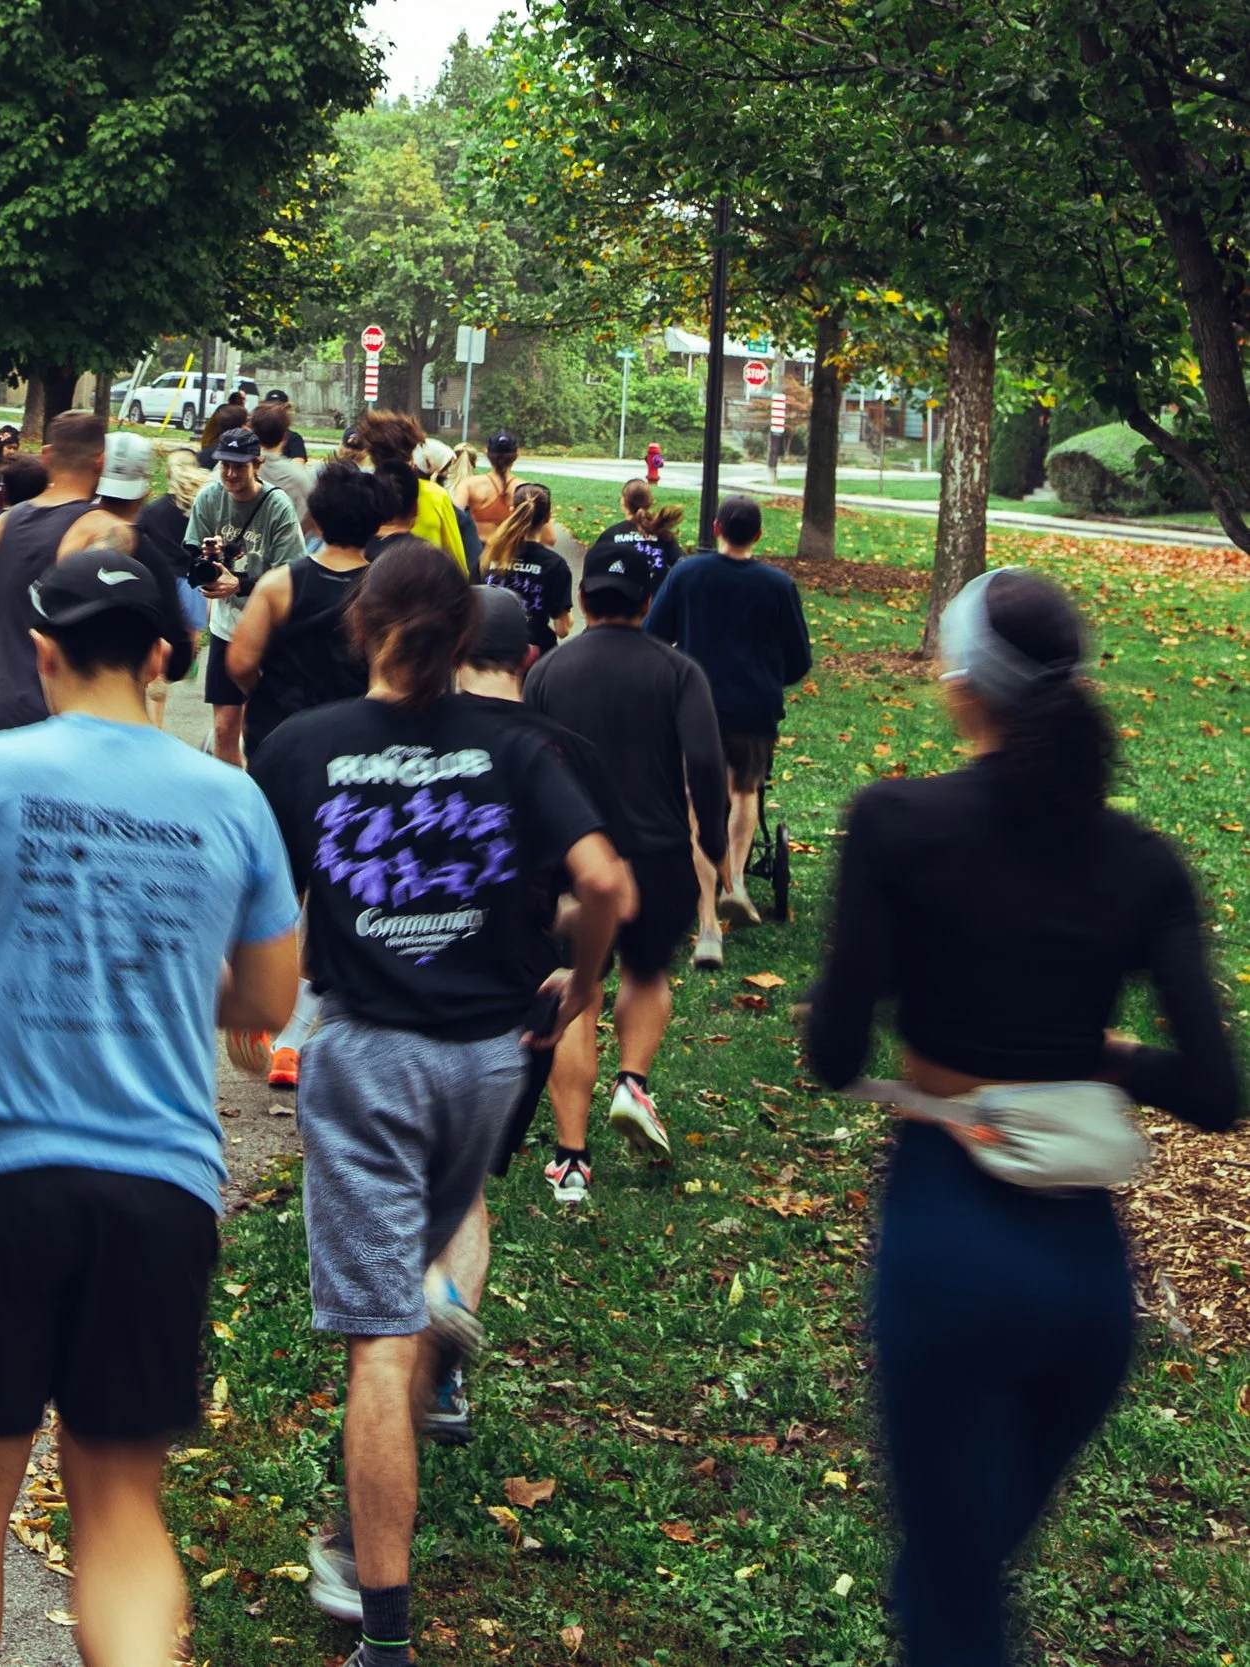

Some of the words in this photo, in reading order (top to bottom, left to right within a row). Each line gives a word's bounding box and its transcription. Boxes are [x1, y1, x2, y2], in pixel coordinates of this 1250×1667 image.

[363, 334, 383, 345] STOP
[745, 367, 765, 379] STOP
[614, 534, 634, 543] RUN
[513, 563, 542, 575] CLUB
